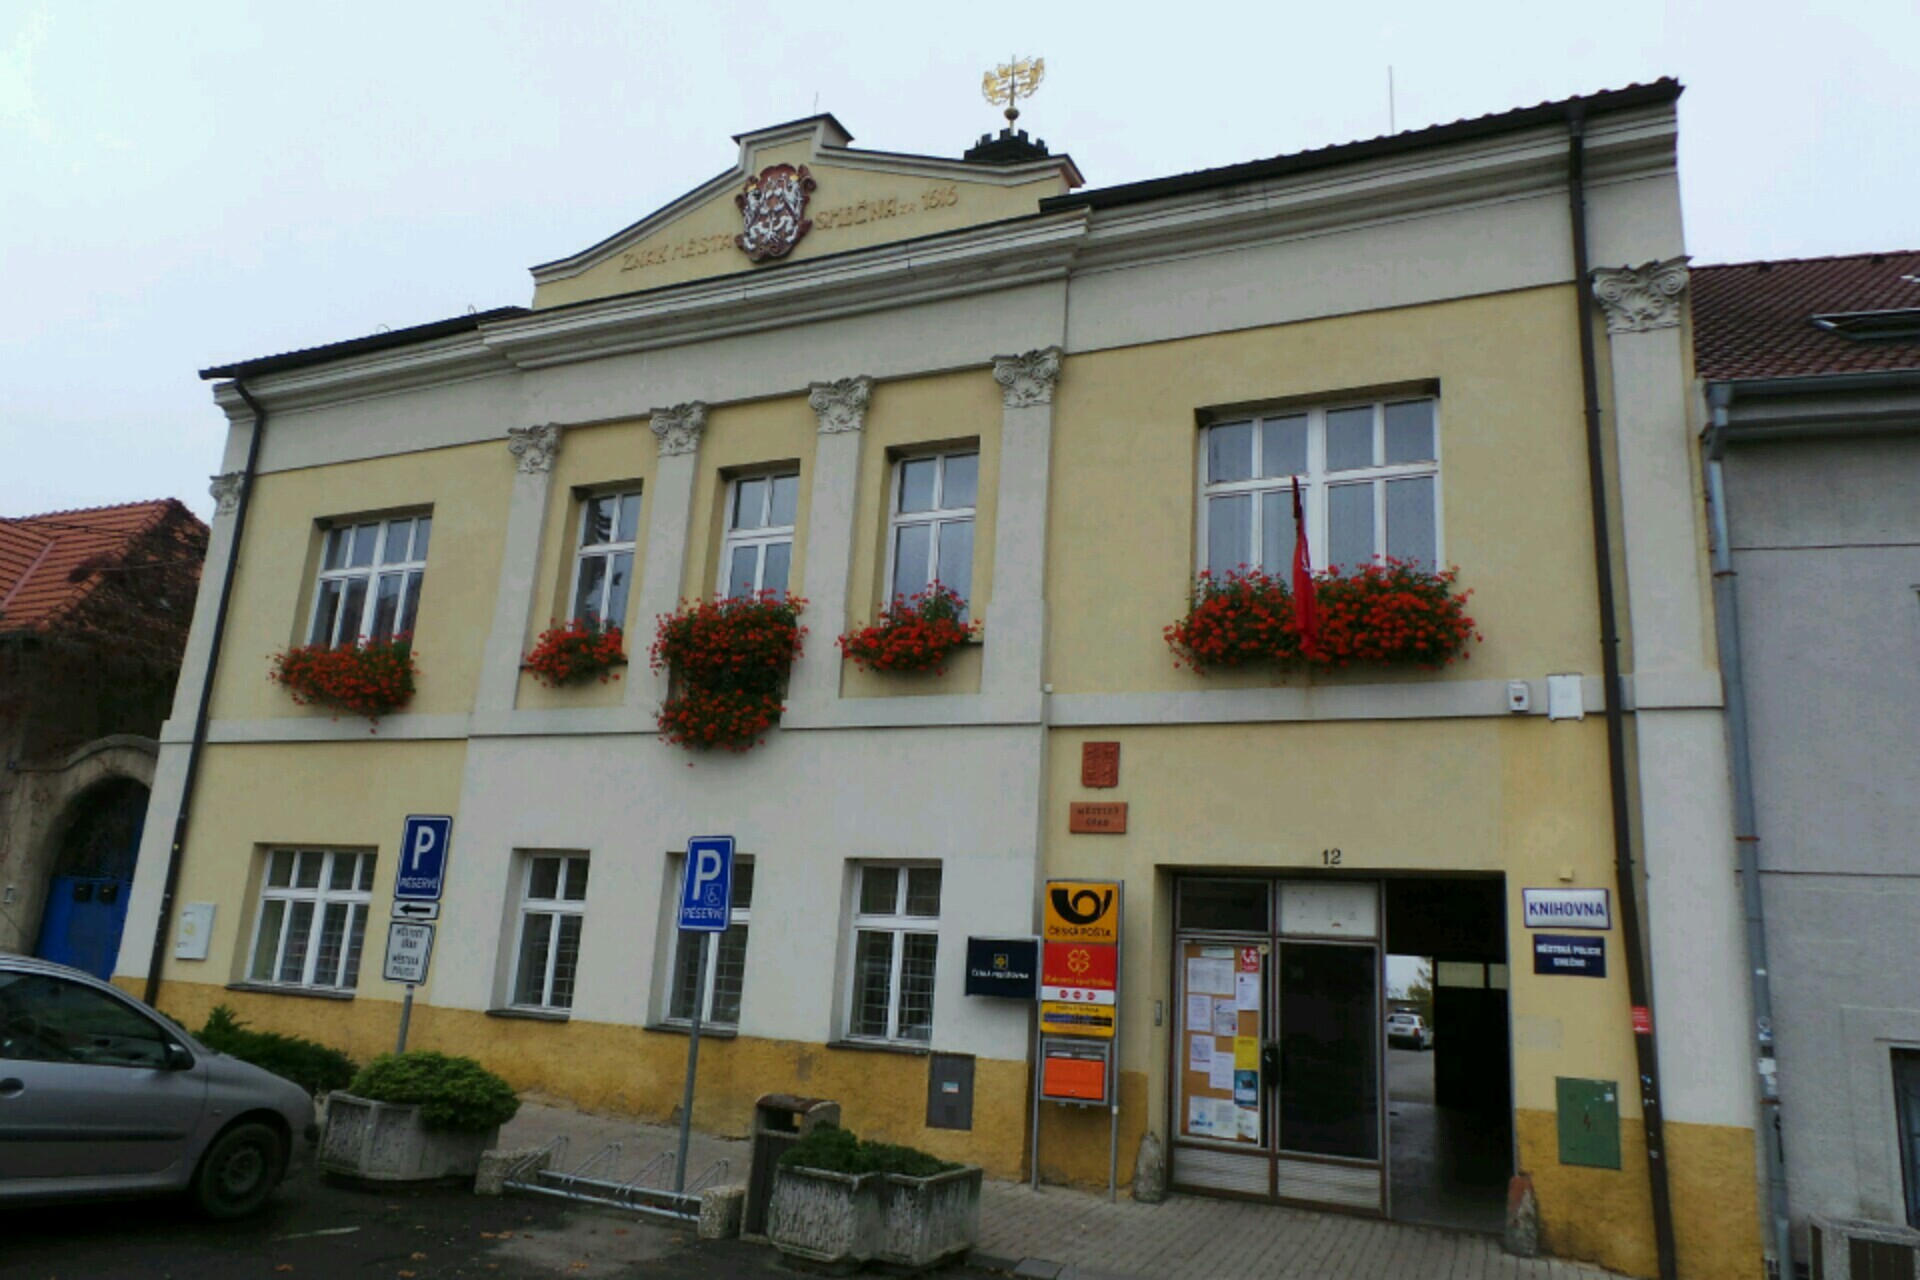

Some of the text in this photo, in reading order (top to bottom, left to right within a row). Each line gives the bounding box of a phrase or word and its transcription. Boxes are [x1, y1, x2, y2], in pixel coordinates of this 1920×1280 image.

[412, 826, 435, 870] P
[1322, 848, 1341, 865] 12
[692, 849, 721, 900] P
[1529, 901, 1605, 917] KNIHOVNA
